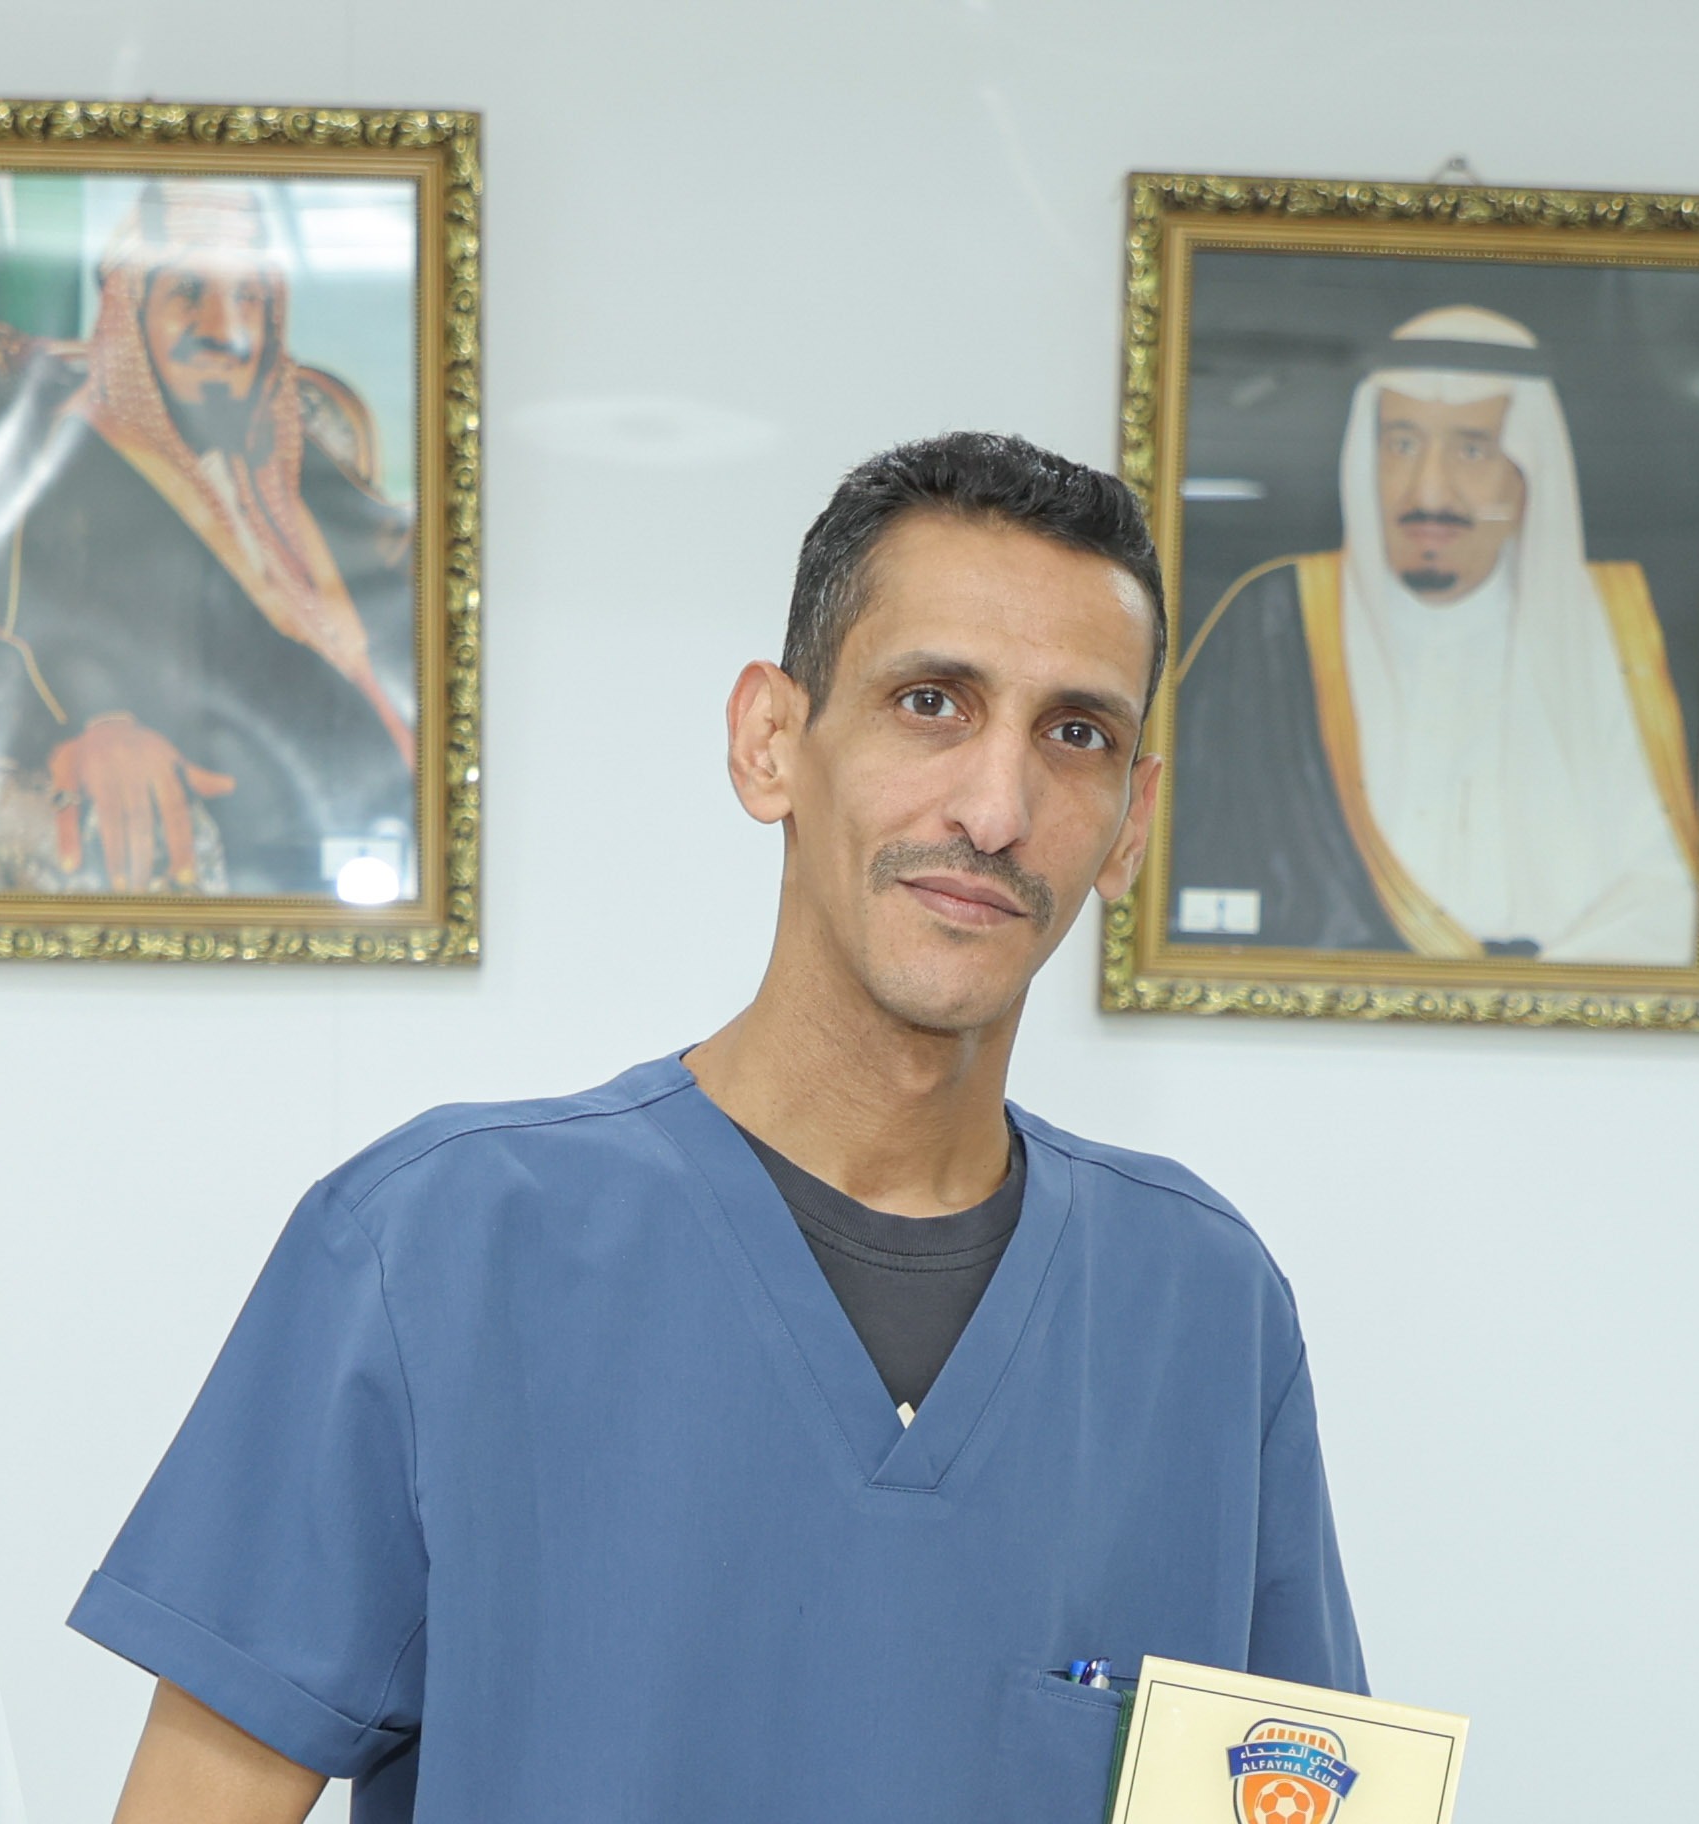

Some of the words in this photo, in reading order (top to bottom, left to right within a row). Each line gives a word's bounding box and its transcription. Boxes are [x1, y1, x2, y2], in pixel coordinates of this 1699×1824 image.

[1240, 1745, 1309, 1760] الفيحاء
[1242, 1760, 1301, 1773] ALFAYHA
[1306, 1766, 1339, 1789] CLUB
[1309, 1756, 1348, 1777] نادي
